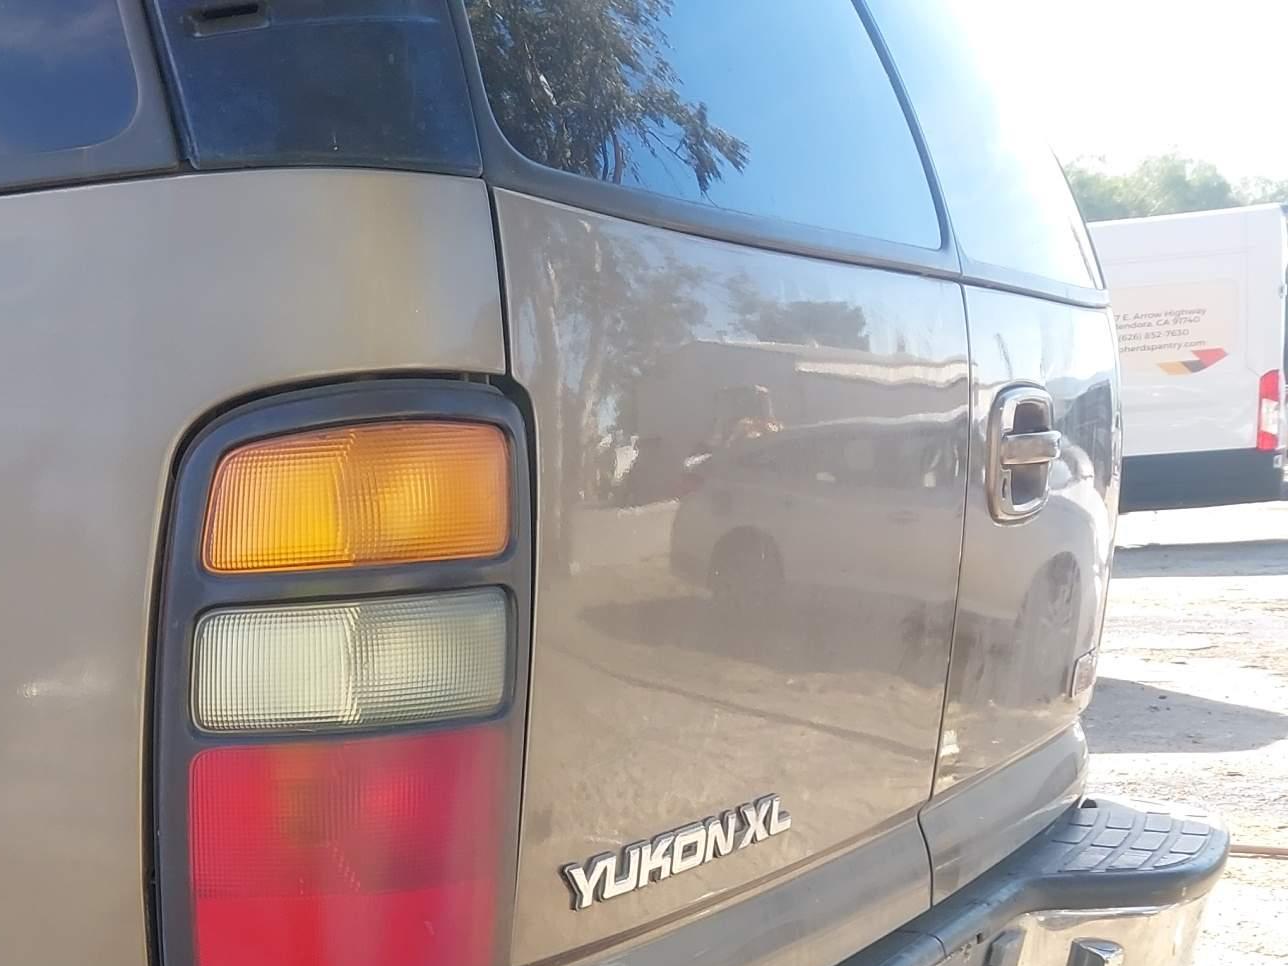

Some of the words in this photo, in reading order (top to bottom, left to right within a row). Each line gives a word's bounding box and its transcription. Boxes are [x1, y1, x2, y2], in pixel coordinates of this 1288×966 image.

[1132, 312, 1162, 320] Arrow
[1163, 308, 1207, 318] Highway
[1156, 318, 1170, 327] CA
[562, 810, 737, 911] YUKON
[738, 793, 791, 849] XL
